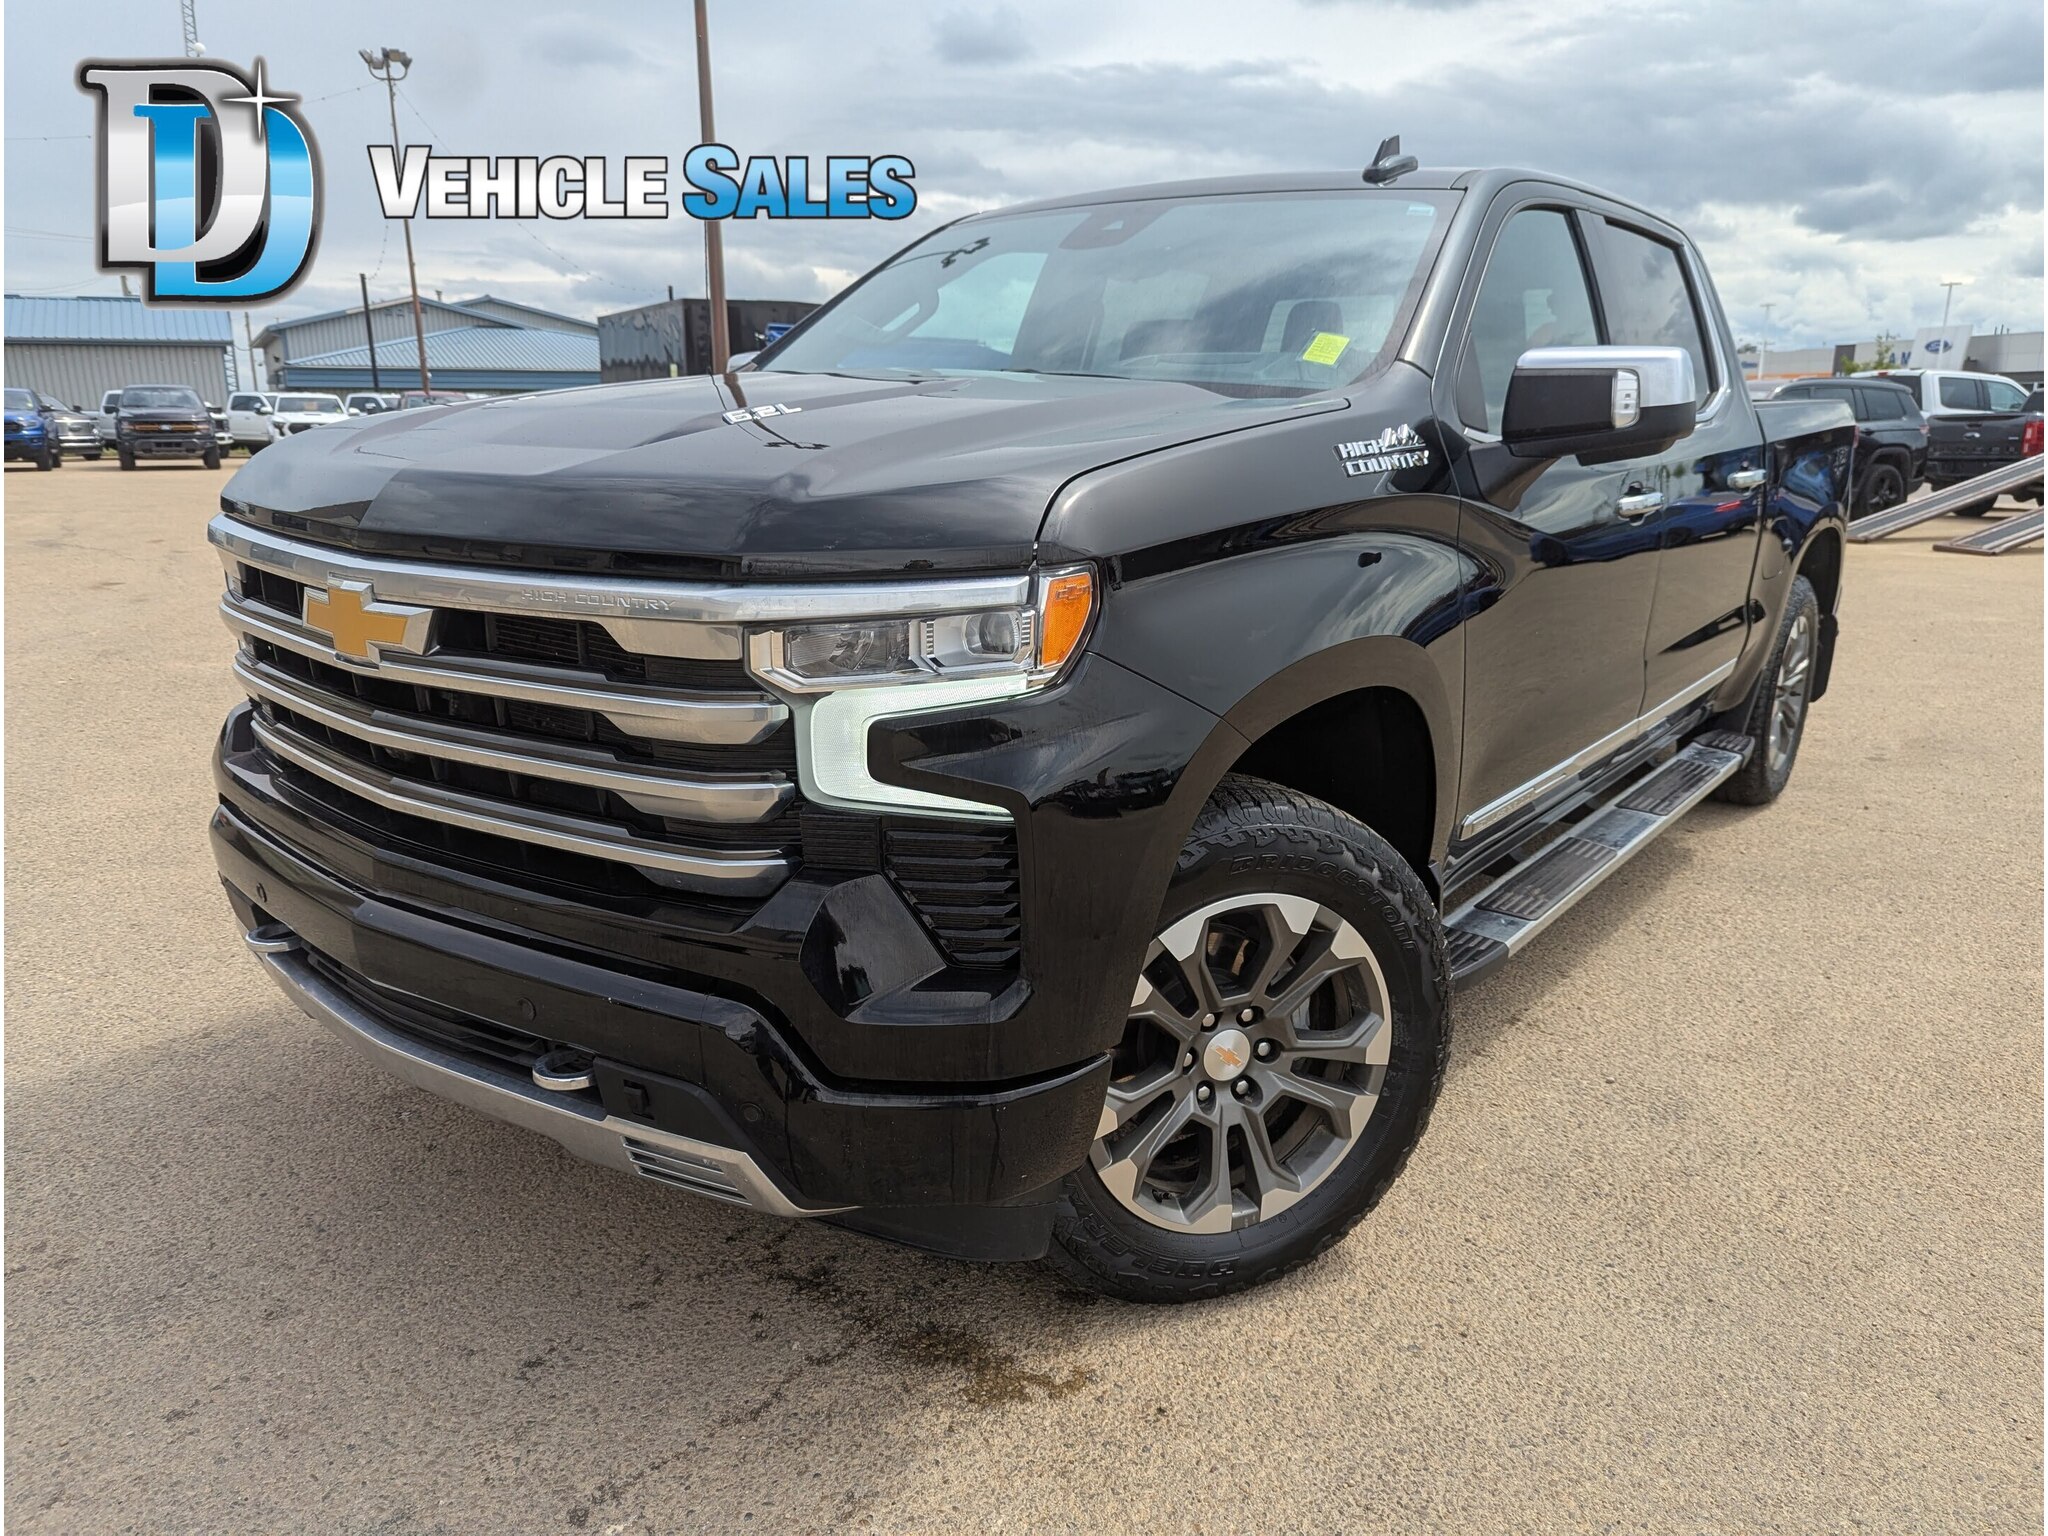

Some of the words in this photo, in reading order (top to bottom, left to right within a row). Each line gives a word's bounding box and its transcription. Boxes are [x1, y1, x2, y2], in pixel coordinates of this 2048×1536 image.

[1338, 439, 1387, 459] HIGH
[1345, 450, 1429, 476] COUNTRY
[521, 589, 567, 603] HIGH
[575, 593, 675, 611] COUNTRY
[1229, 853, 1420, 954] BRIDGESTONE
